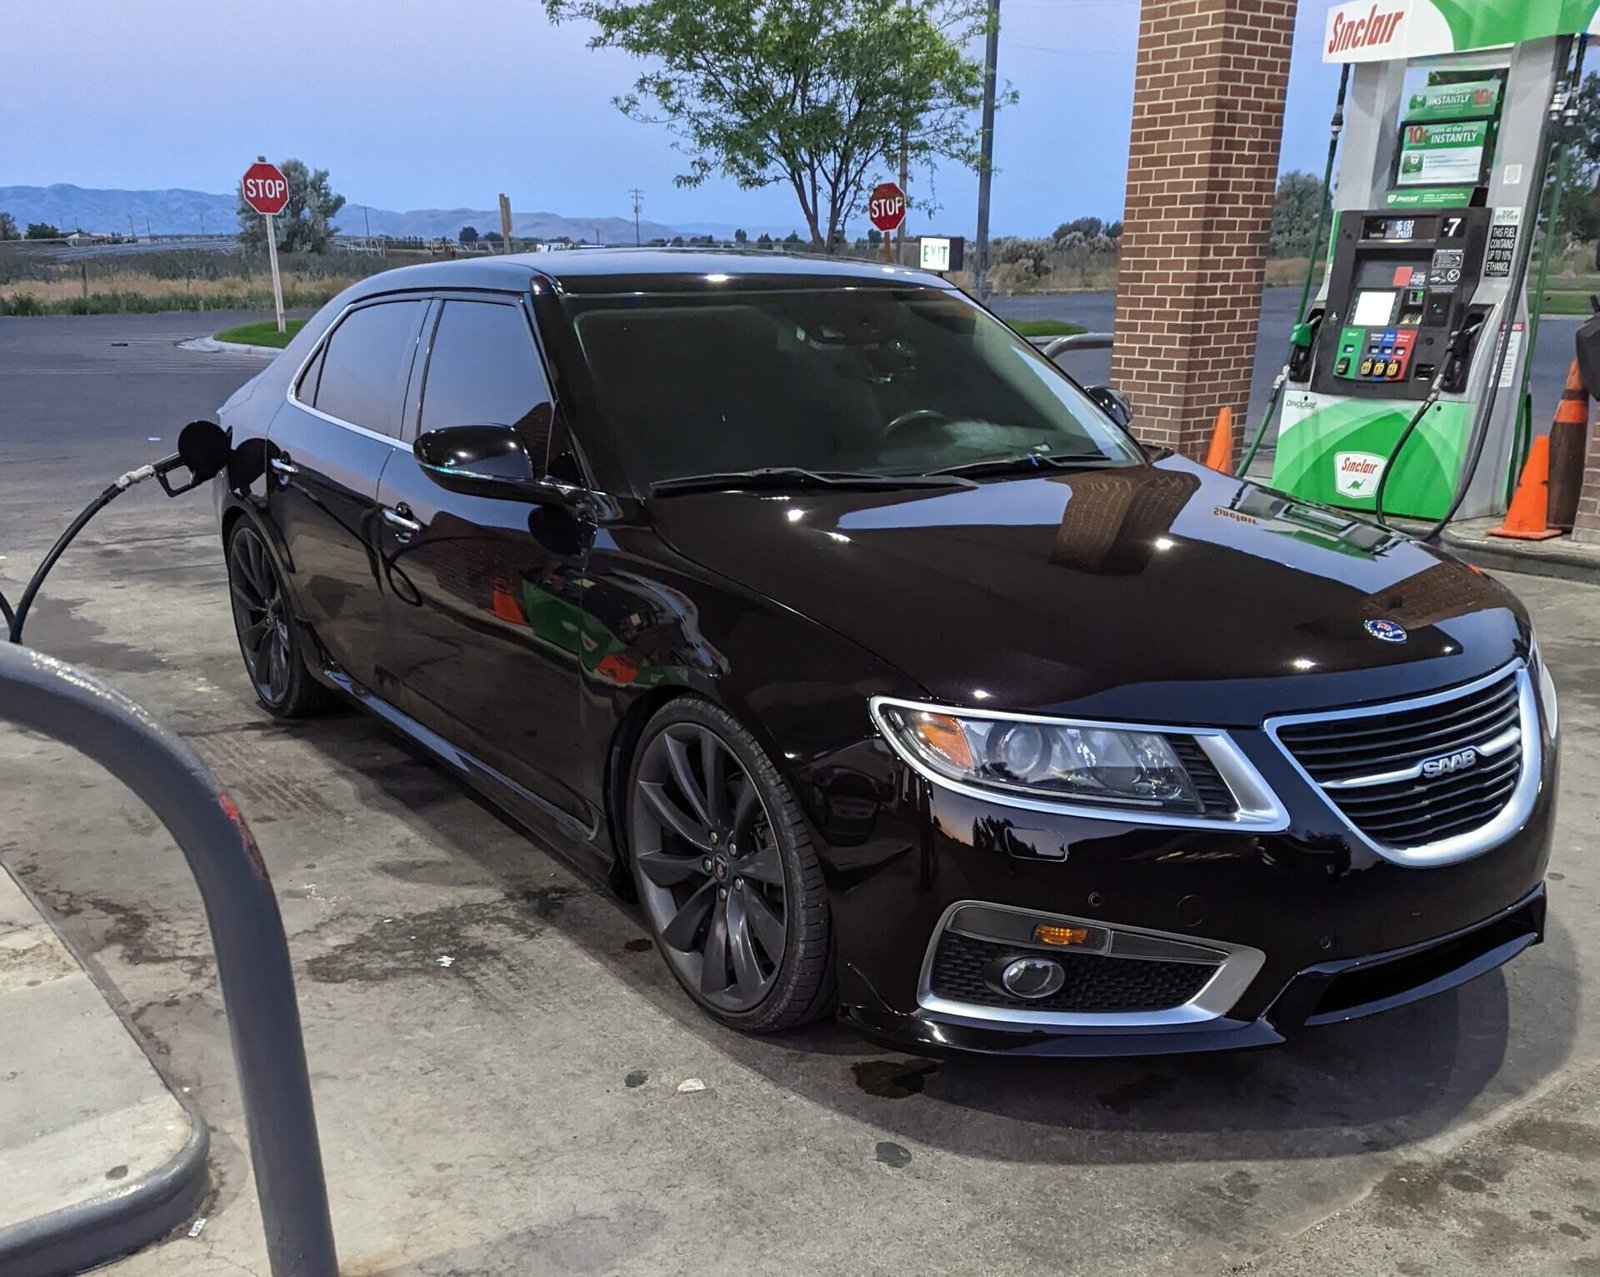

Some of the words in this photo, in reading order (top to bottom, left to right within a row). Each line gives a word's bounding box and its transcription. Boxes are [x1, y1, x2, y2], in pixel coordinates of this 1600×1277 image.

[1328, 4, 1404, 54] Sinclair
[1427, 94, 1470, 105] INSTANTLY
[1431, 132, 1477, 144] INSTANTLY
[246, 179, 285, 199] STOP
[871, 196, 903, 218] STOP
[1493, 227, 1504, 237] THIS
[1504, 227, 1515, 238] FUEL
[1490, 238, 1514, 249] CONTAINS
[923, 245, 948, 264] EXIT
[1488, 250, 1495, 260] UP
[1495, 250, 1501, 260] TO
[1486, 261, 1509, 272] ETHANOL
[1341, 457, 1378, 474] Sinclair
[1423, 749, 1477, 778] SAAB
